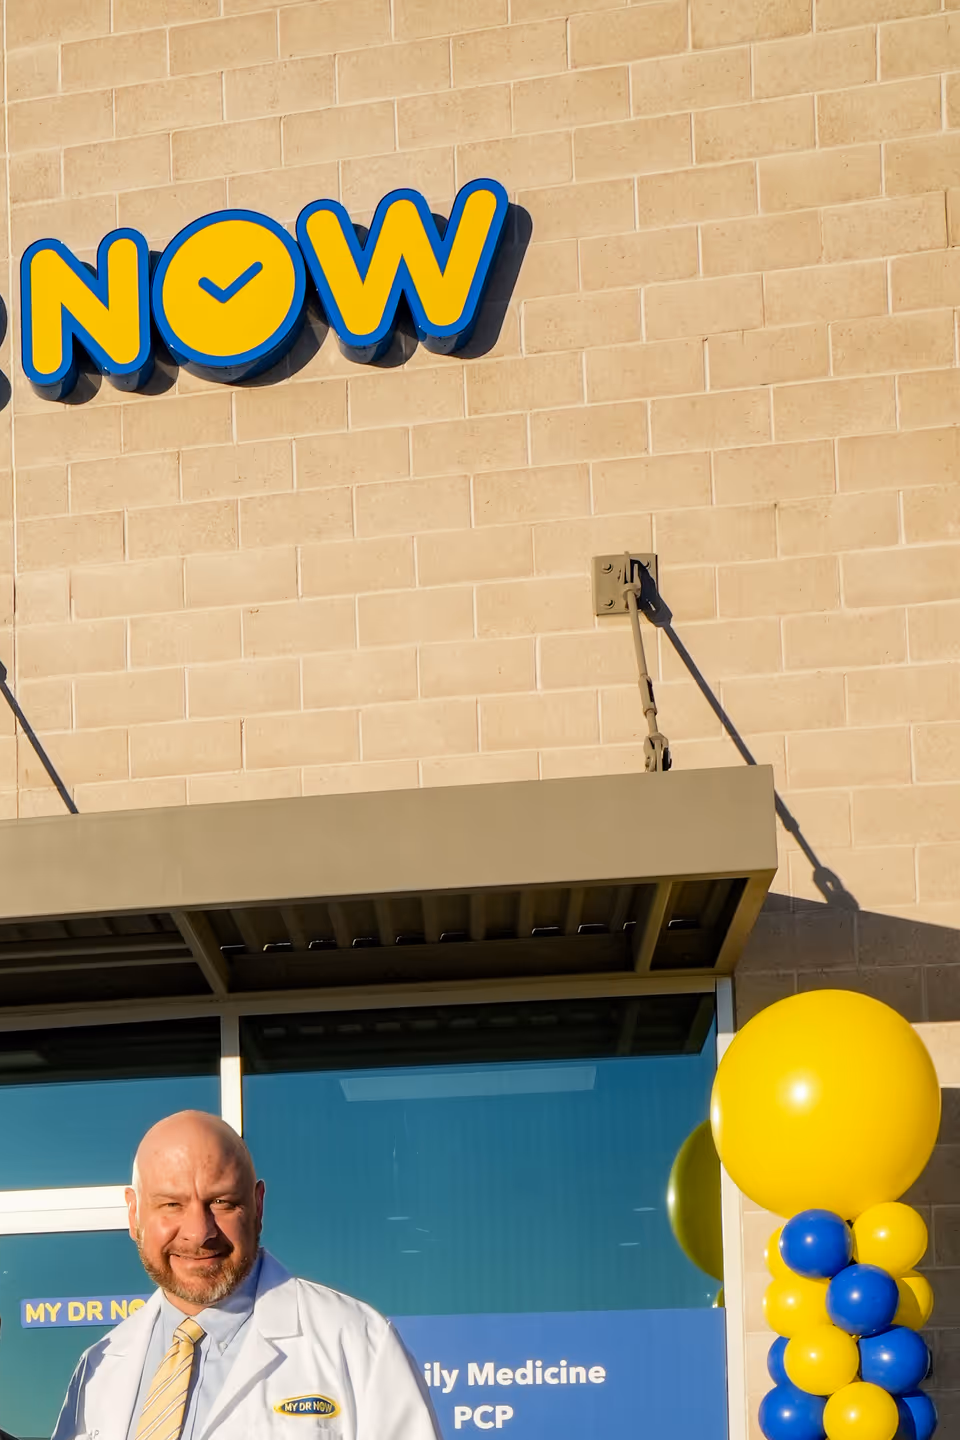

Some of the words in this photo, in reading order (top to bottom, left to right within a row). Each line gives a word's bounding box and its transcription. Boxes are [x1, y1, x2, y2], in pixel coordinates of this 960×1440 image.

[20, 178, 509, 385] NOW
[26, 1302, 62, 1323] MY
[68, 1300, 103, 1322] DR
[467, 1359, 607, 1386] Medicine
[284, 1402, 298, 1412] MY
[300, 1401, 312, 1411] DR
[454, 1404, 514, 1430] PCP
